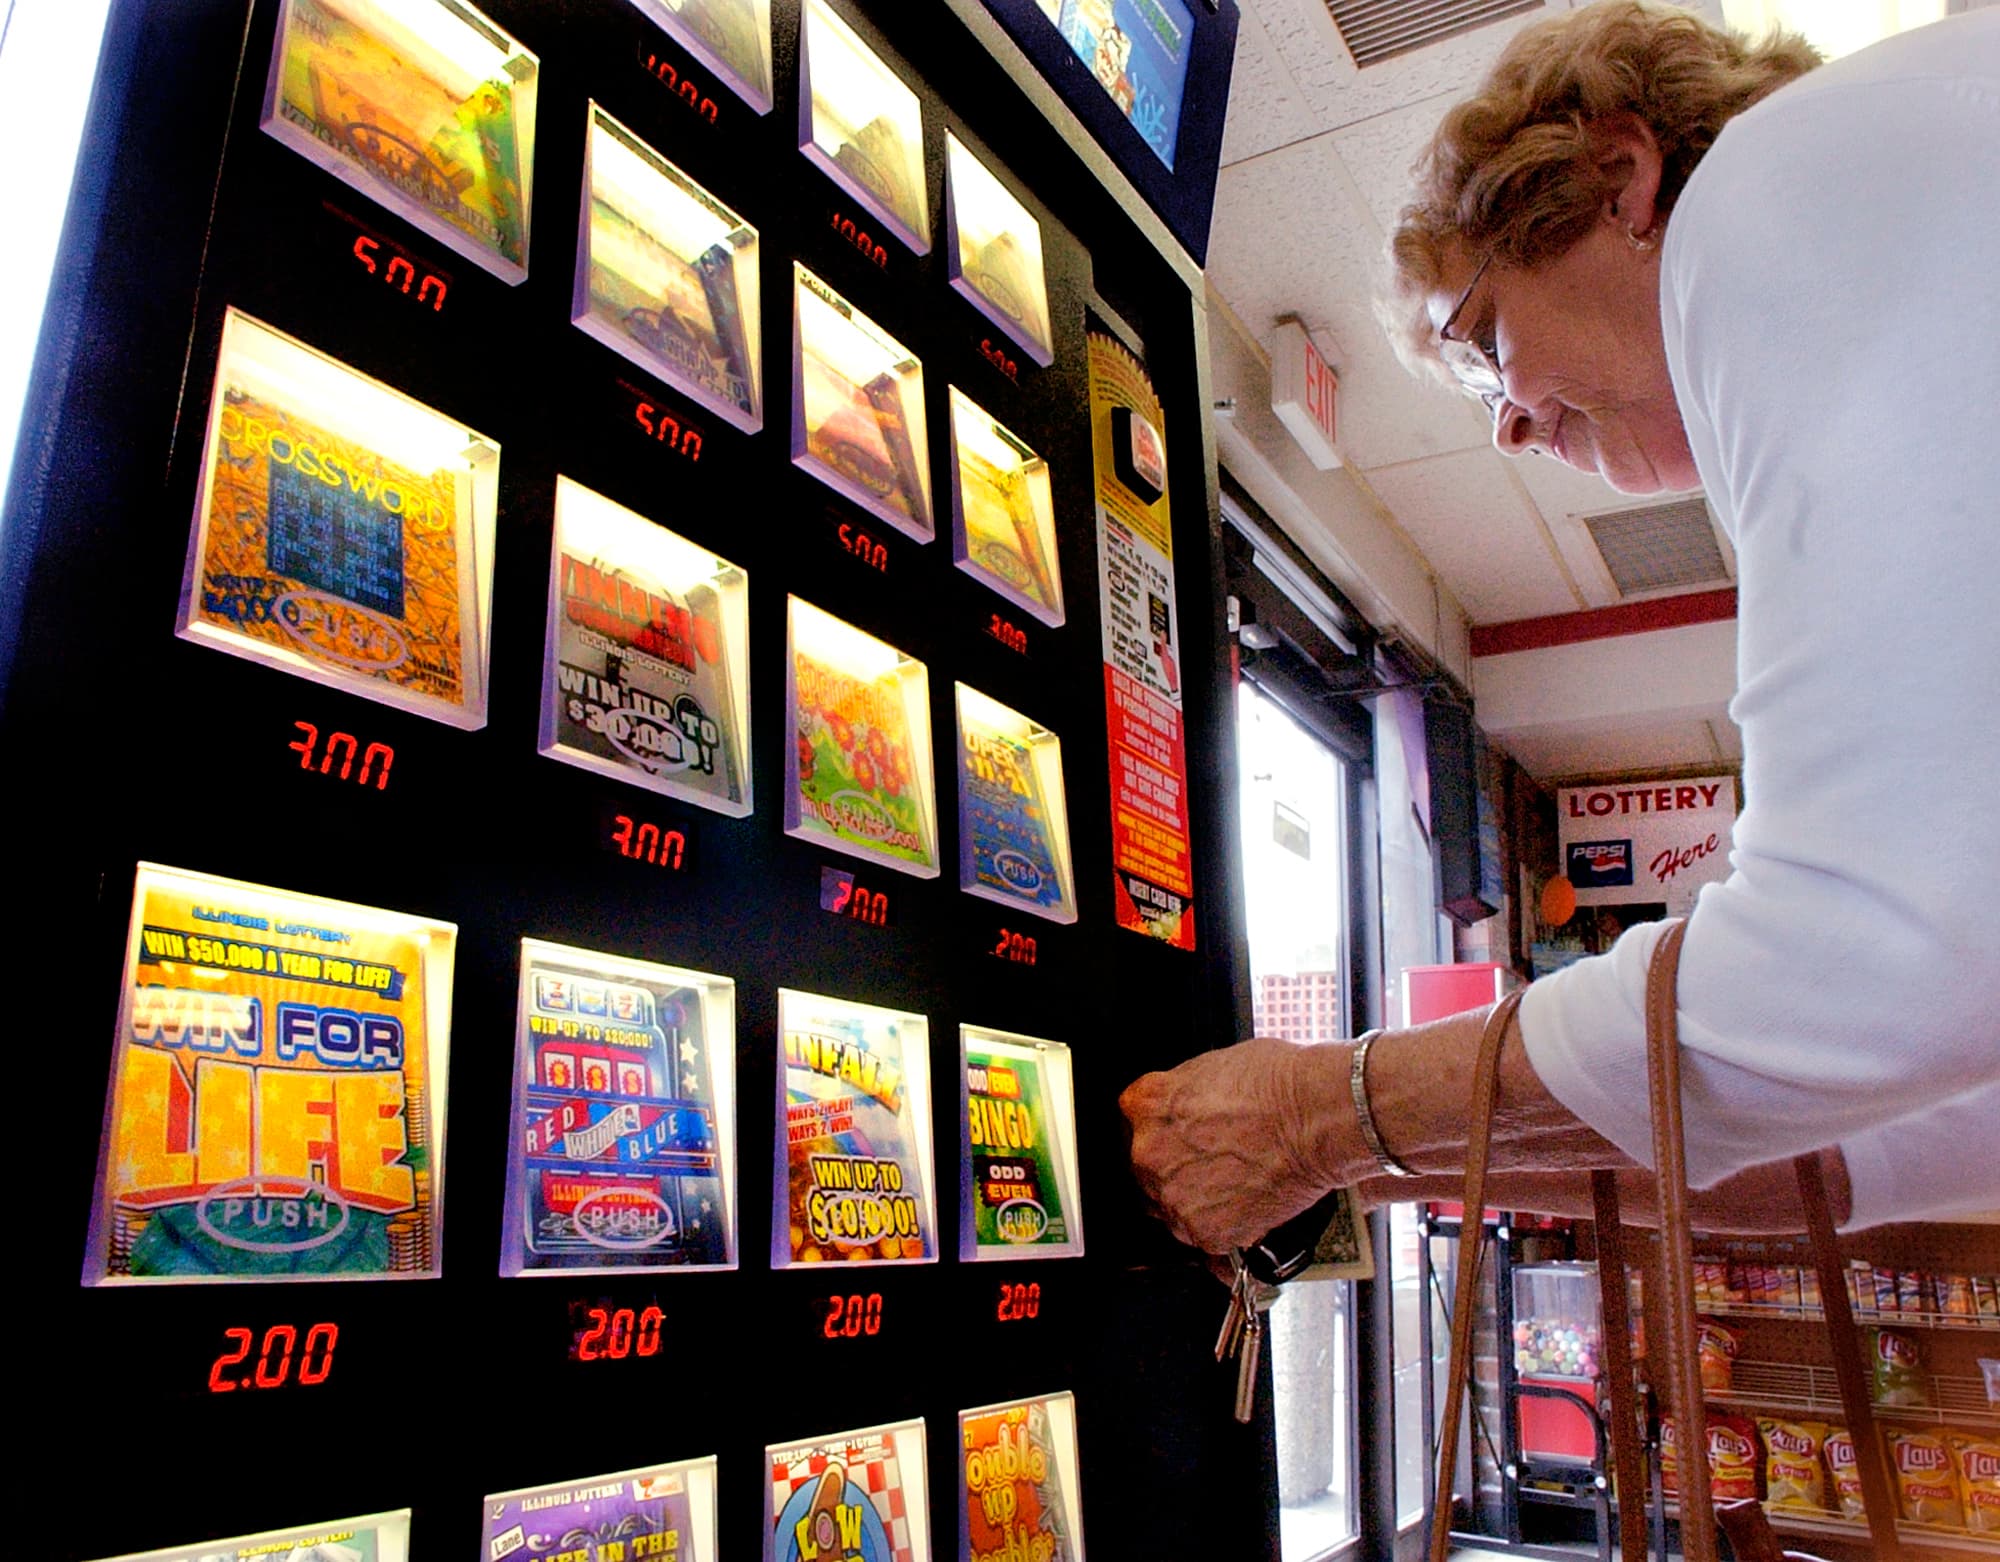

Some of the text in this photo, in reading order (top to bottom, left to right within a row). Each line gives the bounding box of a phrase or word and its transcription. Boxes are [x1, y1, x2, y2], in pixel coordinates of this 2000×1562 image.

[1306, 340, 1338, 444] EXIT
[219, 408, 448, 531] CROSSWORD
[559, 664, 719, 746] WIN UP TO
[1569, 784, 1720, 818] LOTTERY
[1572, 844, 1626, 860] PEPSI
[1649, 833, 1721, 884] Here
[192, 906, 352, 945] ILLINOIS LOTTERY
[144, 930, 393, 990] WIN $50,000 A YEAR FOR LIFE!
[132, 988, 404, 1068] WIN FOR
[530, 1015, 558, 1035] WIN
[561, 1021, 580, 1038] UP
[584, 1024, 601, 1041] TO
[115, 1043, 416, 1215] LIFE
[787, 1103, 817, 1122] WAYS
[788, 1122, 817, 1142] WAYS
[820, 1120, 828, 1137] 2
[968, 1097, 1034, 1150] BINGO
[526, 1105, 679, 1161] RED WHITE BLUE
[812, 1158, 904, 1193] WIN UP TO
[989, 1164, 1026, 1180] ODD
[987, 1182, 1034, 1200] EVEN
[223, 1199, 328, 1229] PUSH
[590, 1206, 660, 1230] PUSH
[577, 1305, 664, 1361] 2.00
[208, 1322, 339, 1393] 2.00
[494, 1531, 522, 1556] Lane
[632, 1529, 679, 1558] THE
